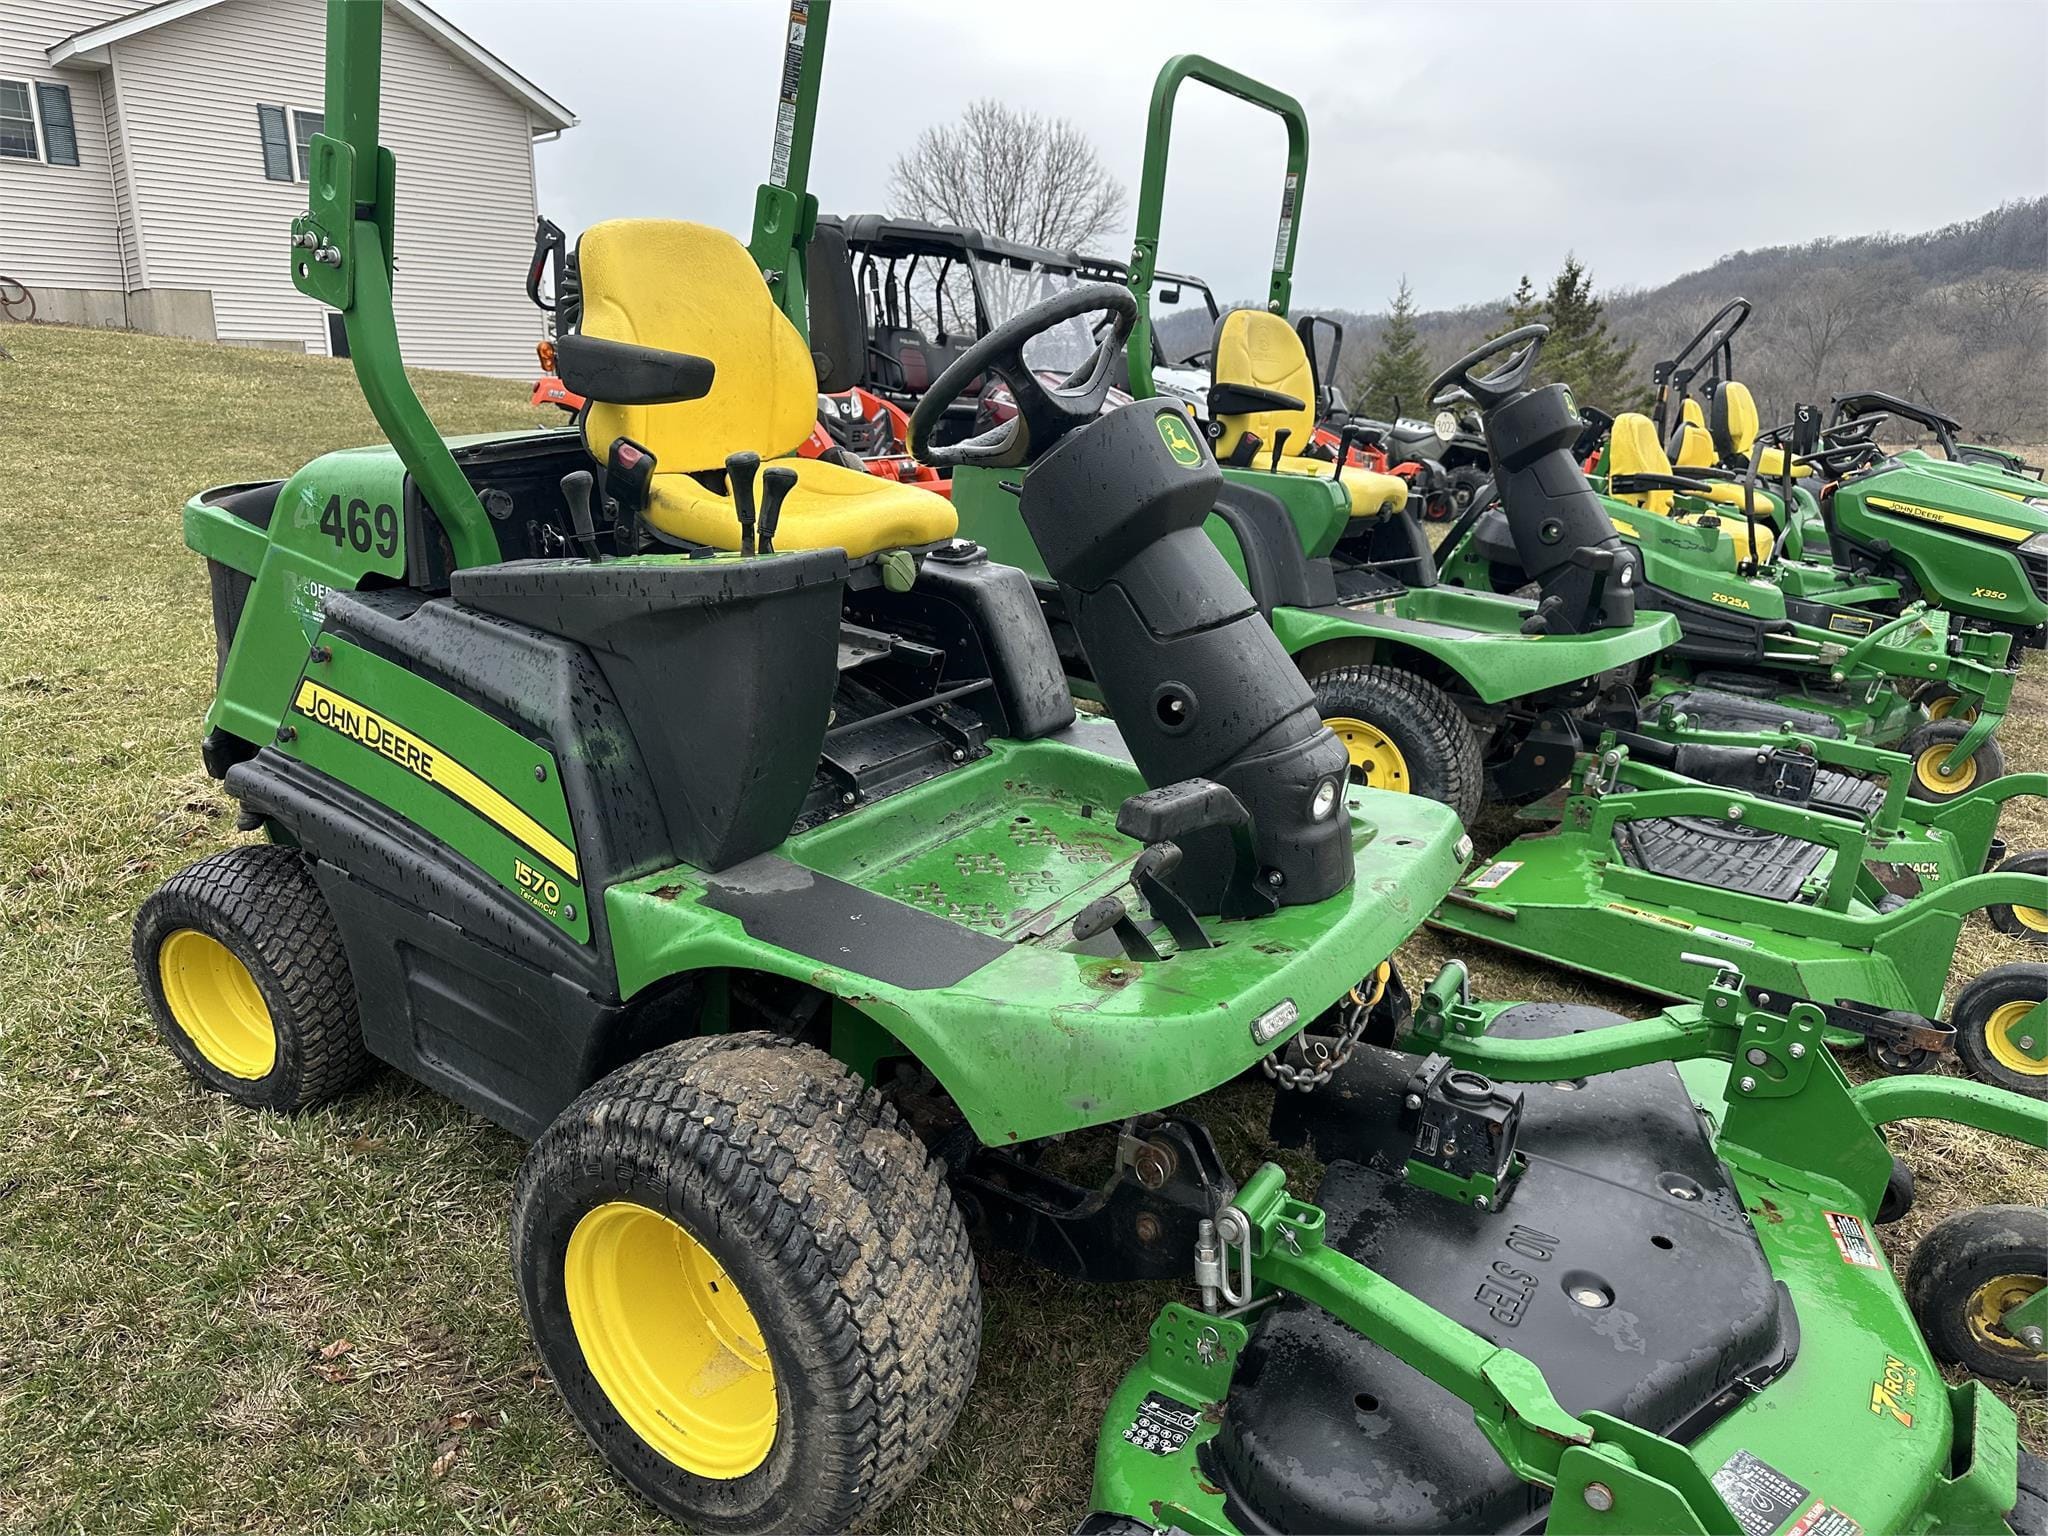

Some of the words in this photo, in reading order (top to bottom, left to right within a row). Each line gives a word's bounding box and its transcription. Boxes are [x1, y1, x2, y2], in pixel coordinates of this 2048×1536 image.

[319, 494, 399, 559] 469
[1889, 502, 1913, 514] JOHN
[1914, 507, 1944, 521] DEERE
[1711, 592, 1751, 610] Z925A
[1971, 587, 2007, 600] X350
[305, 690, 360, 736] JOHN
[364, 715, 433, 778] DEERE
[514, 857, 561, 905] 1570
[520, 887, 557, 917] TerrainCut
[1505, 1224, 1560, 1261] NO
[1474, 1261, 1539, 1328] STEP
